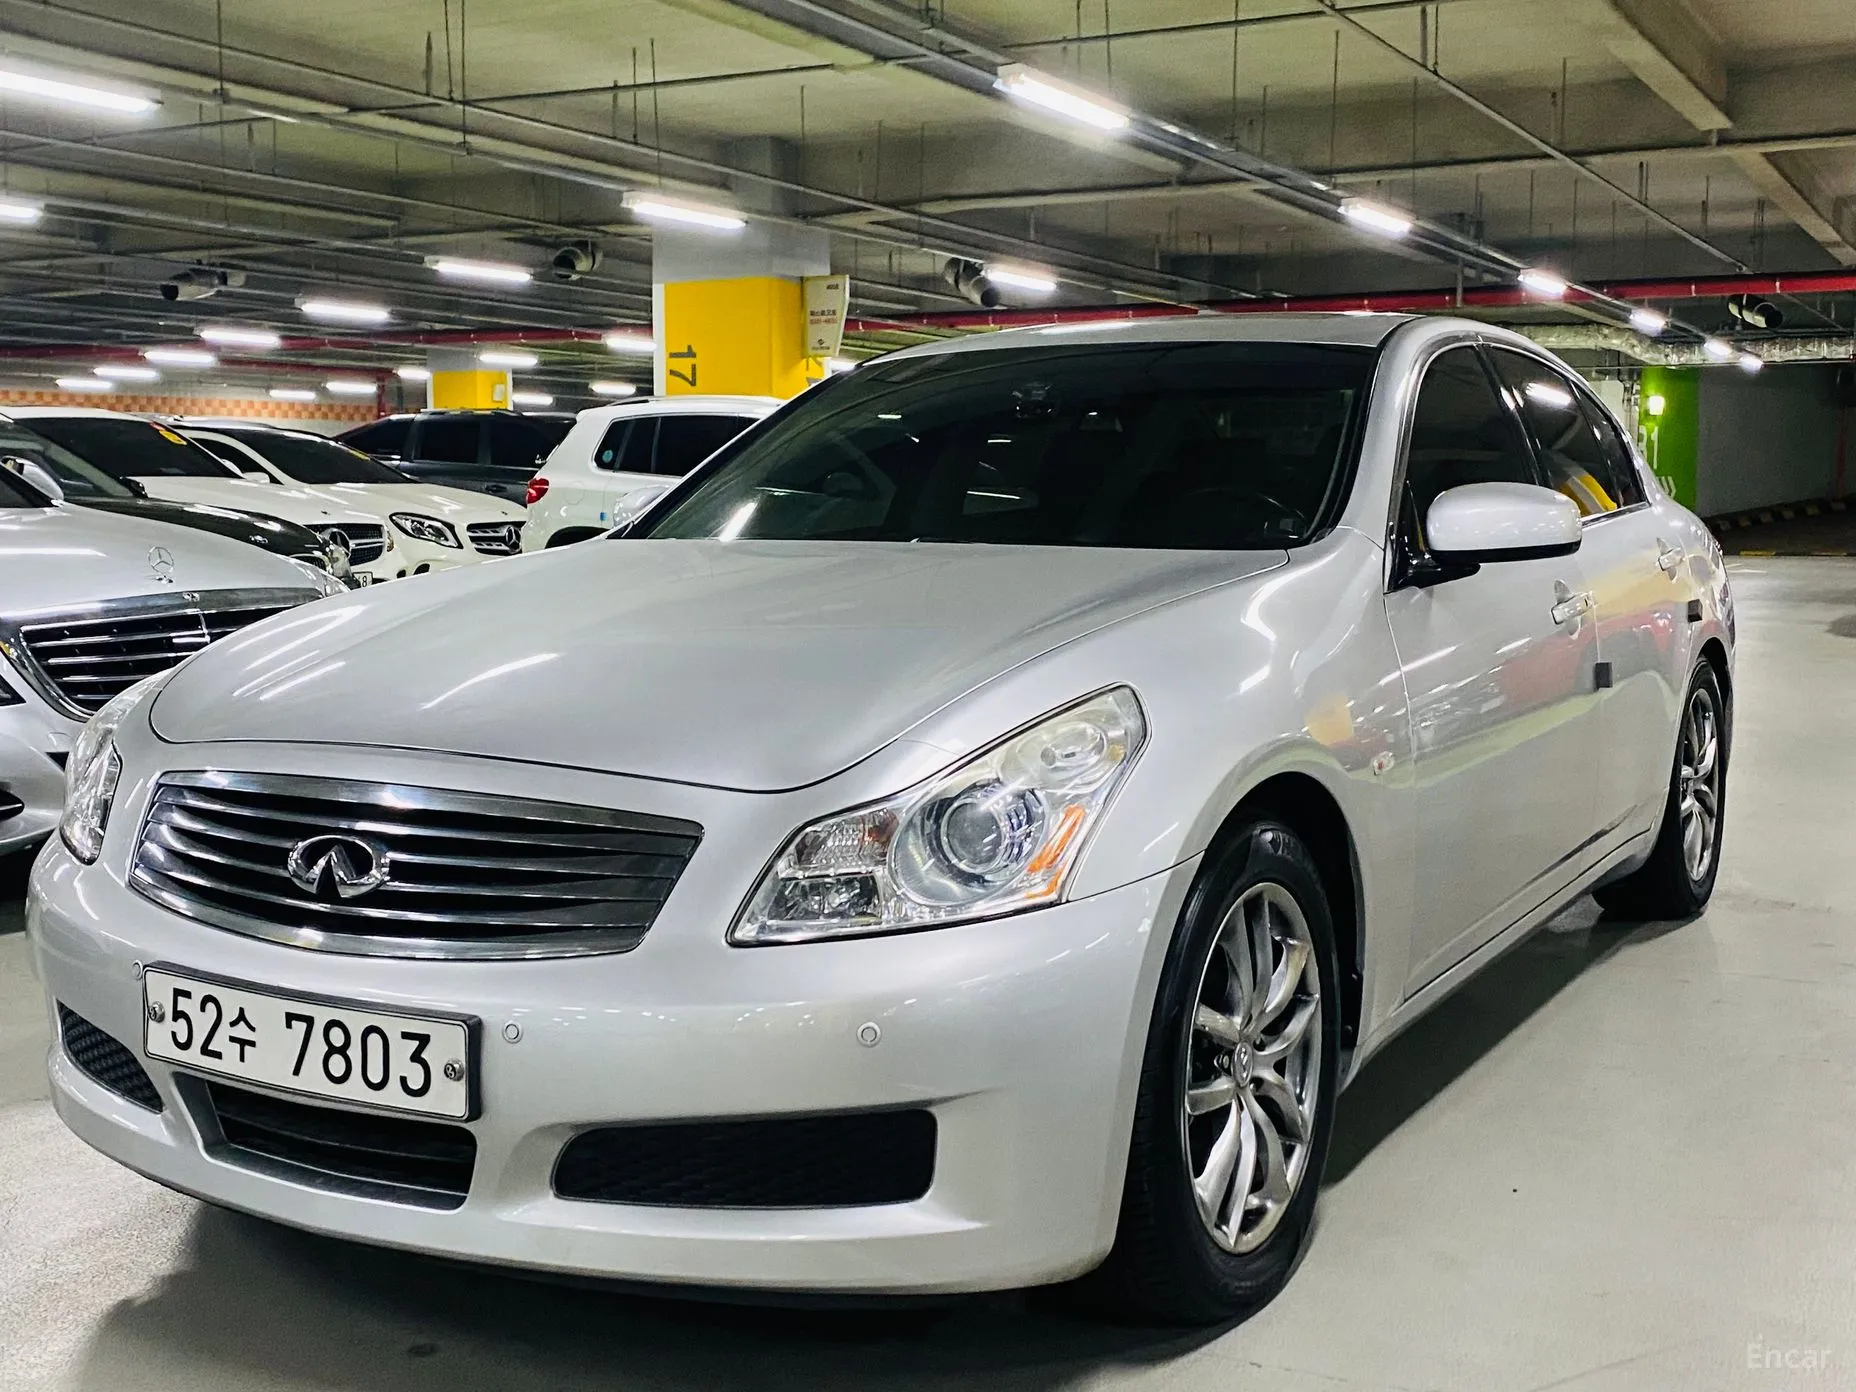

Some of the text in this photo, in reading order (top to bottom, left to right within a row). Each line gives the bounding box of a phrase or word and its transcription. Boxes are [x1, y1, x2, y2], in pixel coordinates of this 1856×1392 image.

[669, 344, 697, 387] 17
[170, 987, 432, 1098] 52수 7803
